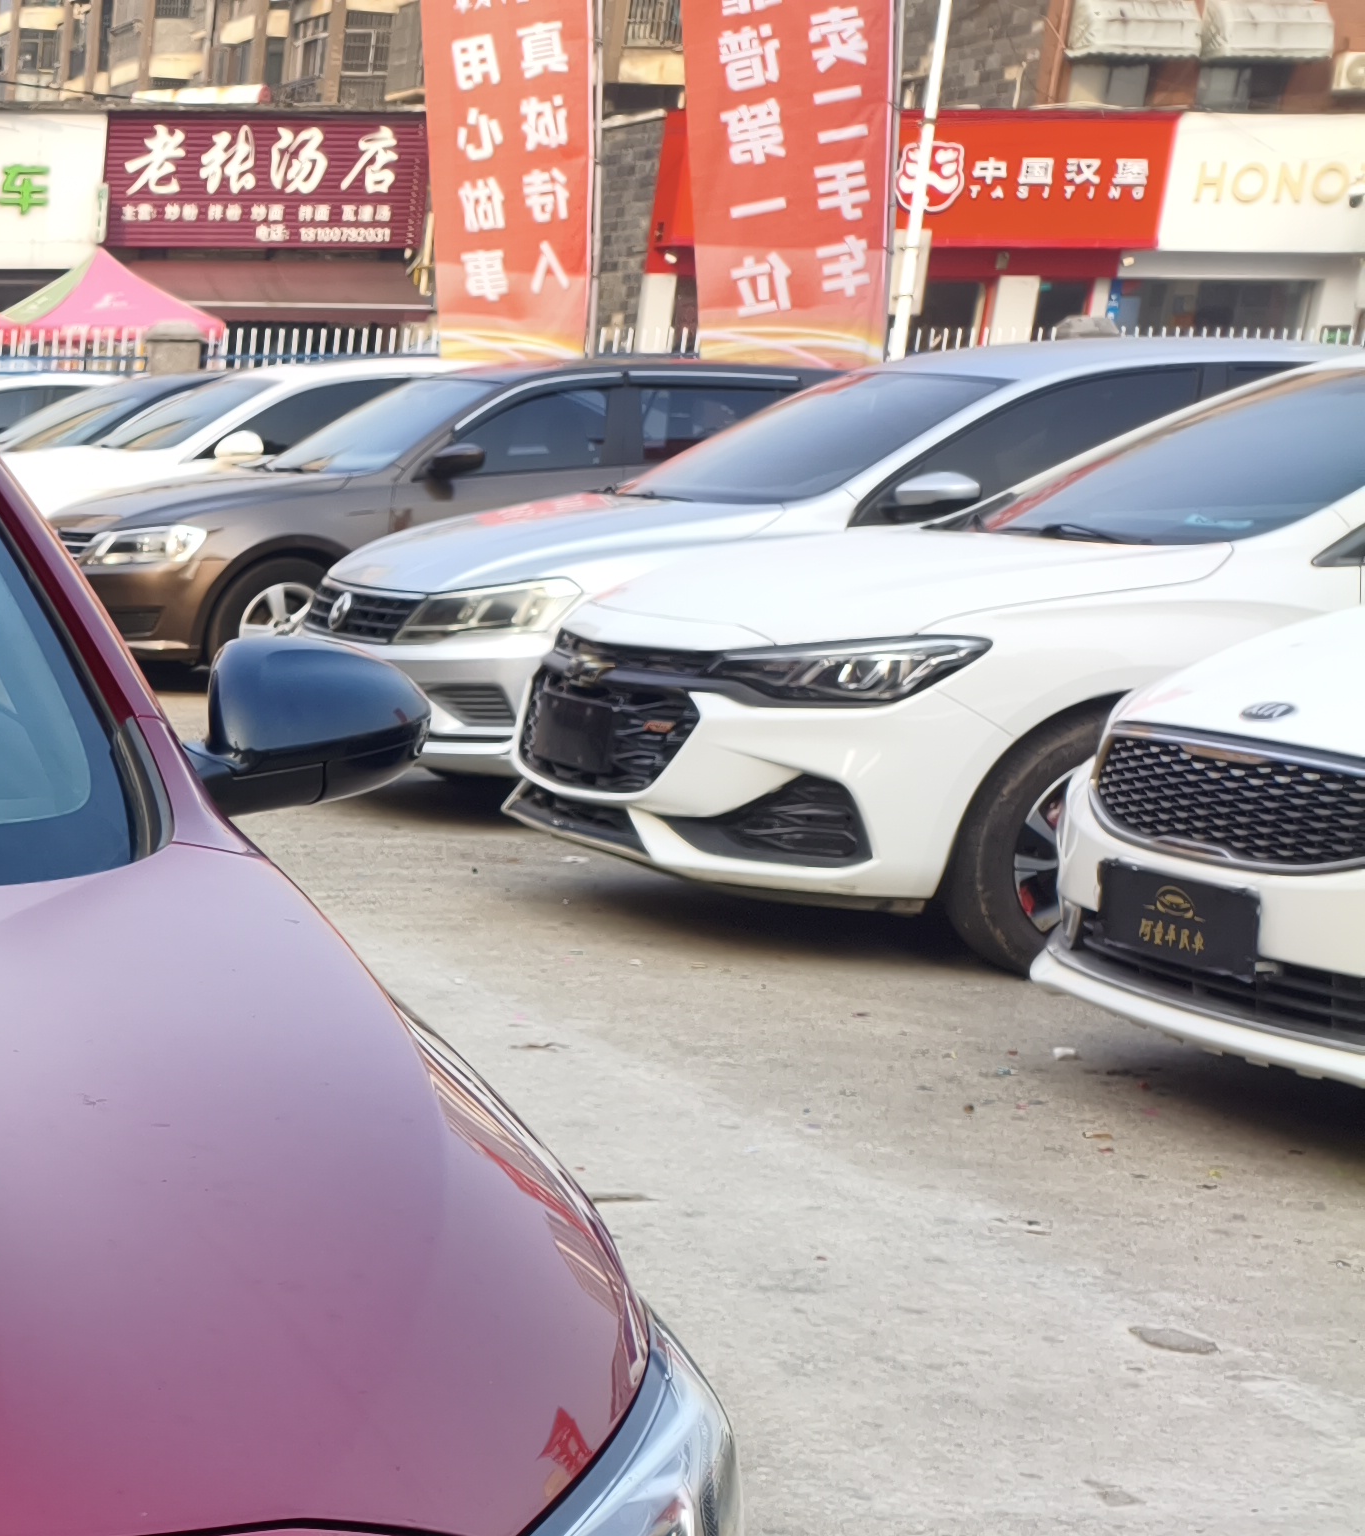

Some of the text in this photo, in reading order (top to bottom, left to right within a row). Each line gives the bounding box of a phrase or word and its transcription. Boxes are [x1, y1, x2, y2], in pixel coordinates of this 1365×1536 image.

[124, 124, 399, 195] 老张汤店
[971, 157, 1150, 185] 中国汉堡
[1193, 161, 1352, 204] HONO
